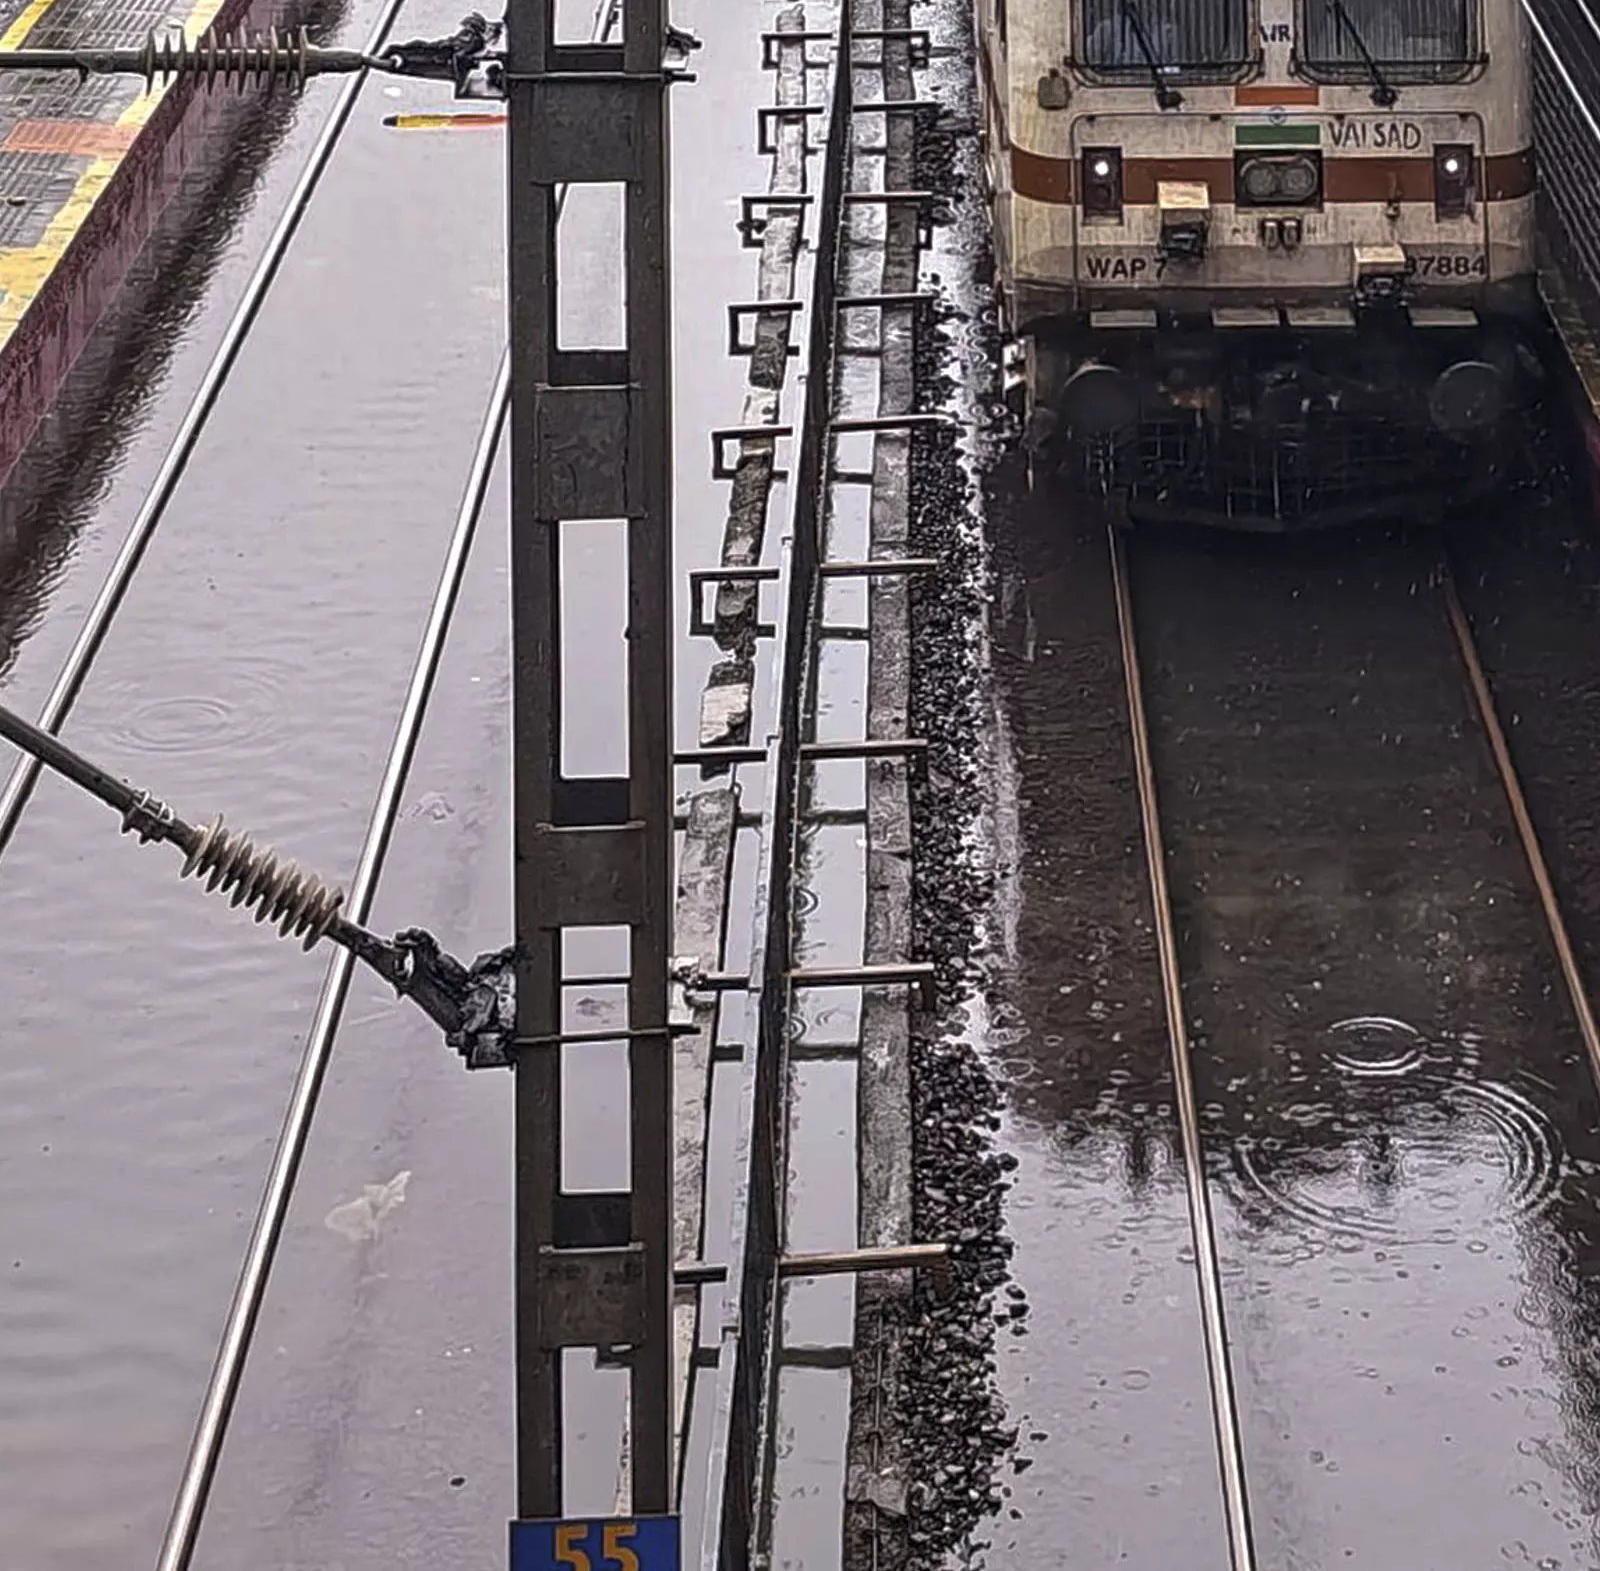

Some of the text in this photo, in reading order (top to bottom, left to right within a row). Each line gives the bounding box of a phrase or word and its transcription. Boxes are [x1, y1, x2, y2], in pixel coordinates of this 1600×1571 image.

[1086, 256, 1167, 280] WAP 7
[555, 1522, 639, 1571] 55
